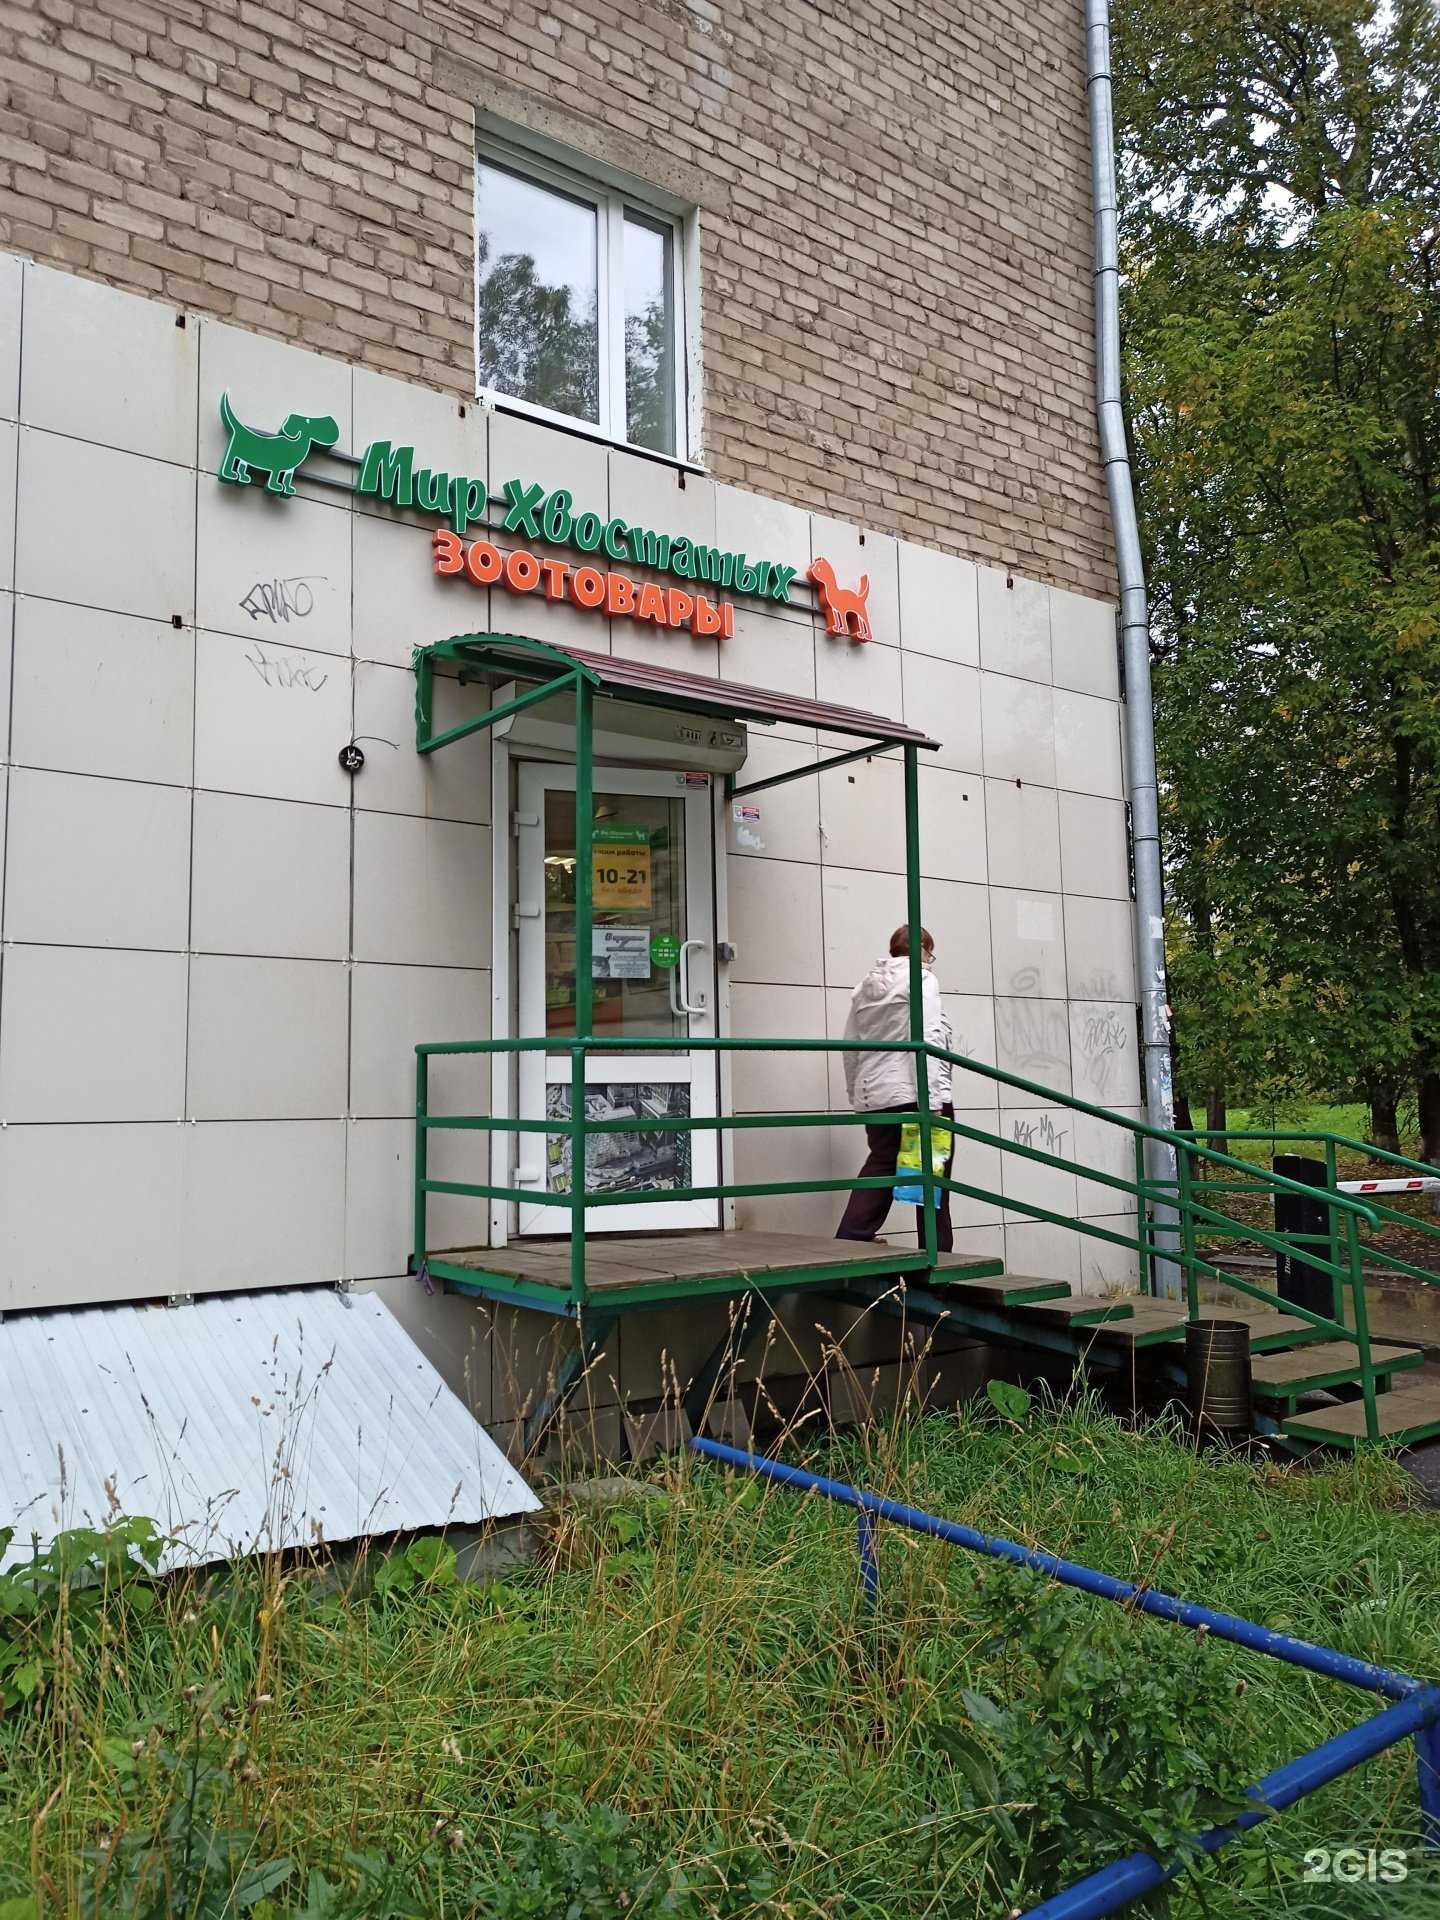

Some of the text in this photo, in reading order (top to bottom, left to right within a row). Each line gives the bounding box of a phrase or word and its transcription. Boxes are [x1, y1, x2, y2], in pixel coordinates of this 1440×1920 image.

[358, 440, 798, 603] Мир Хвостатых
[432, 528, 736, 640] ЗООТОВАРЫ
[596, 868, 647, 884] 10-21
